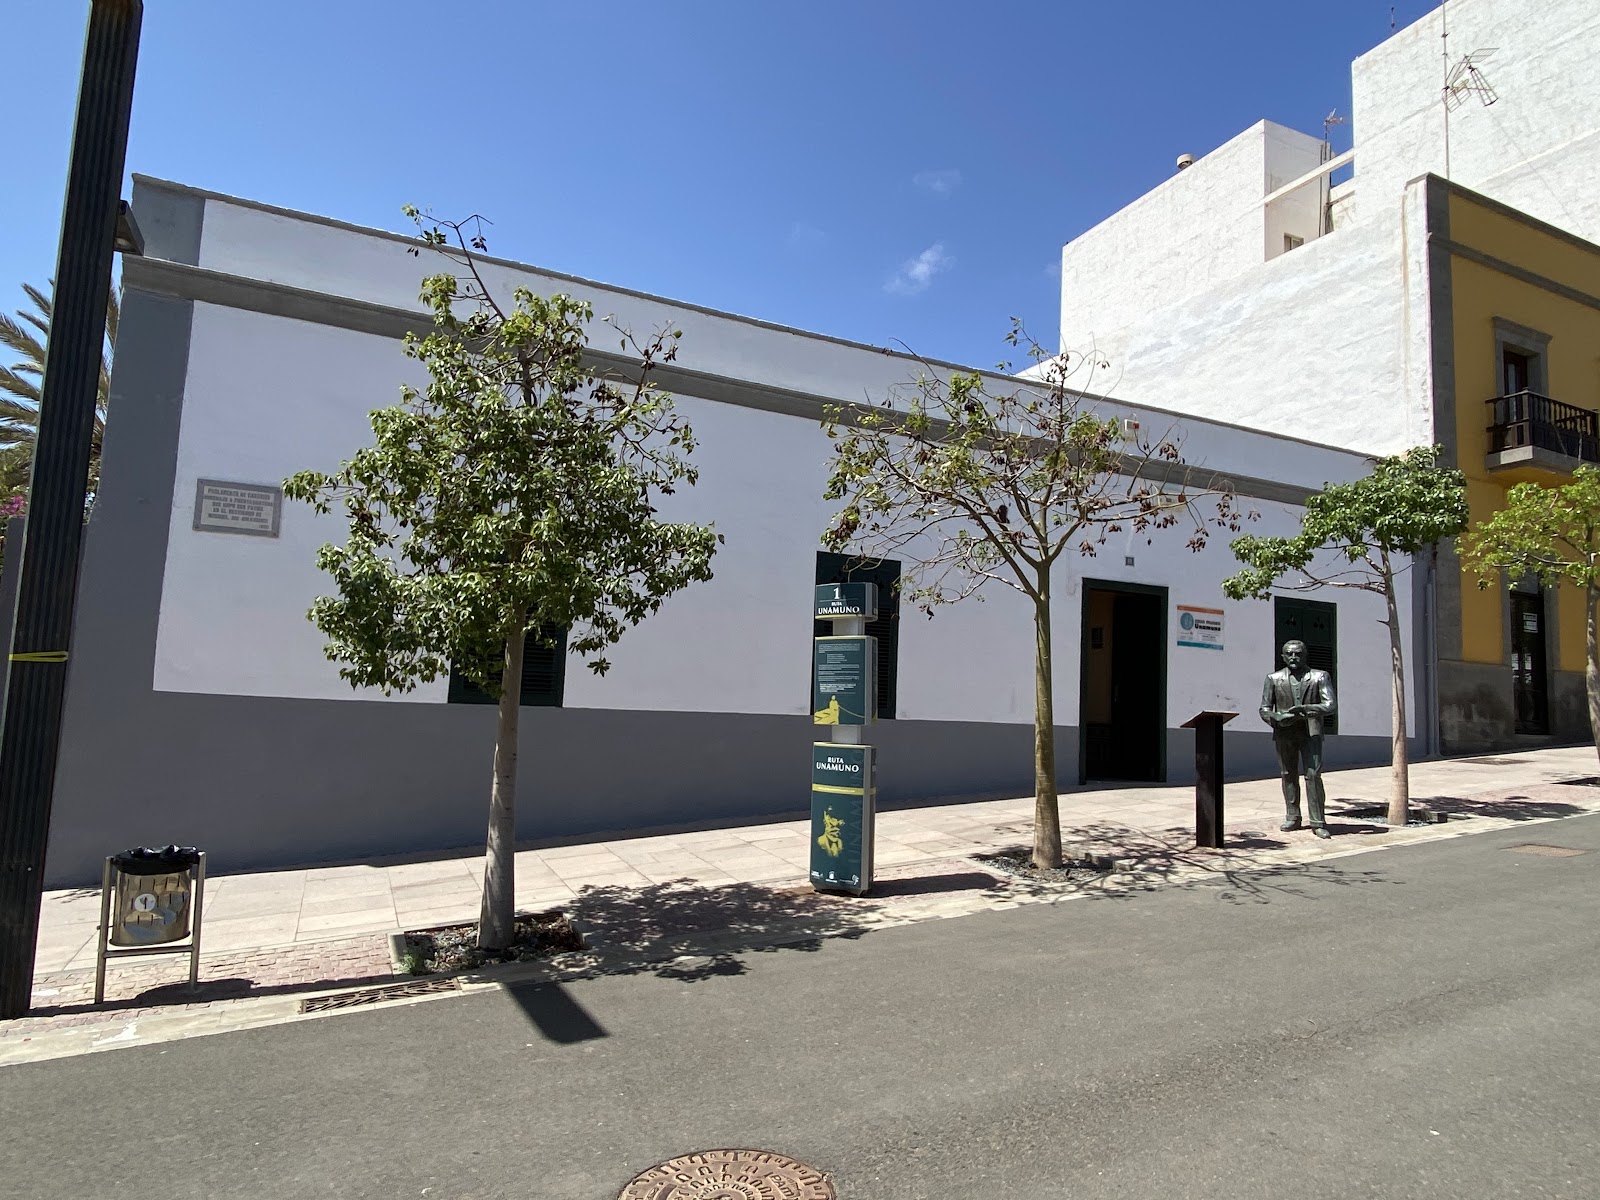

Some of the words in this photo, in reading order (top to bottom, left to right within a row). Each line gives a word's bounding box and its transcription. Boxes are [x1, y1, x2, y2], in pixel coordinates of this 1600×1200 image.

[833, 587, 840, 600] 1
[818, 606, 860, 615] UNAMUNO
[827, 756, 844, 764] RUTA
[816, 761, 860, 773] UNAMUNO
